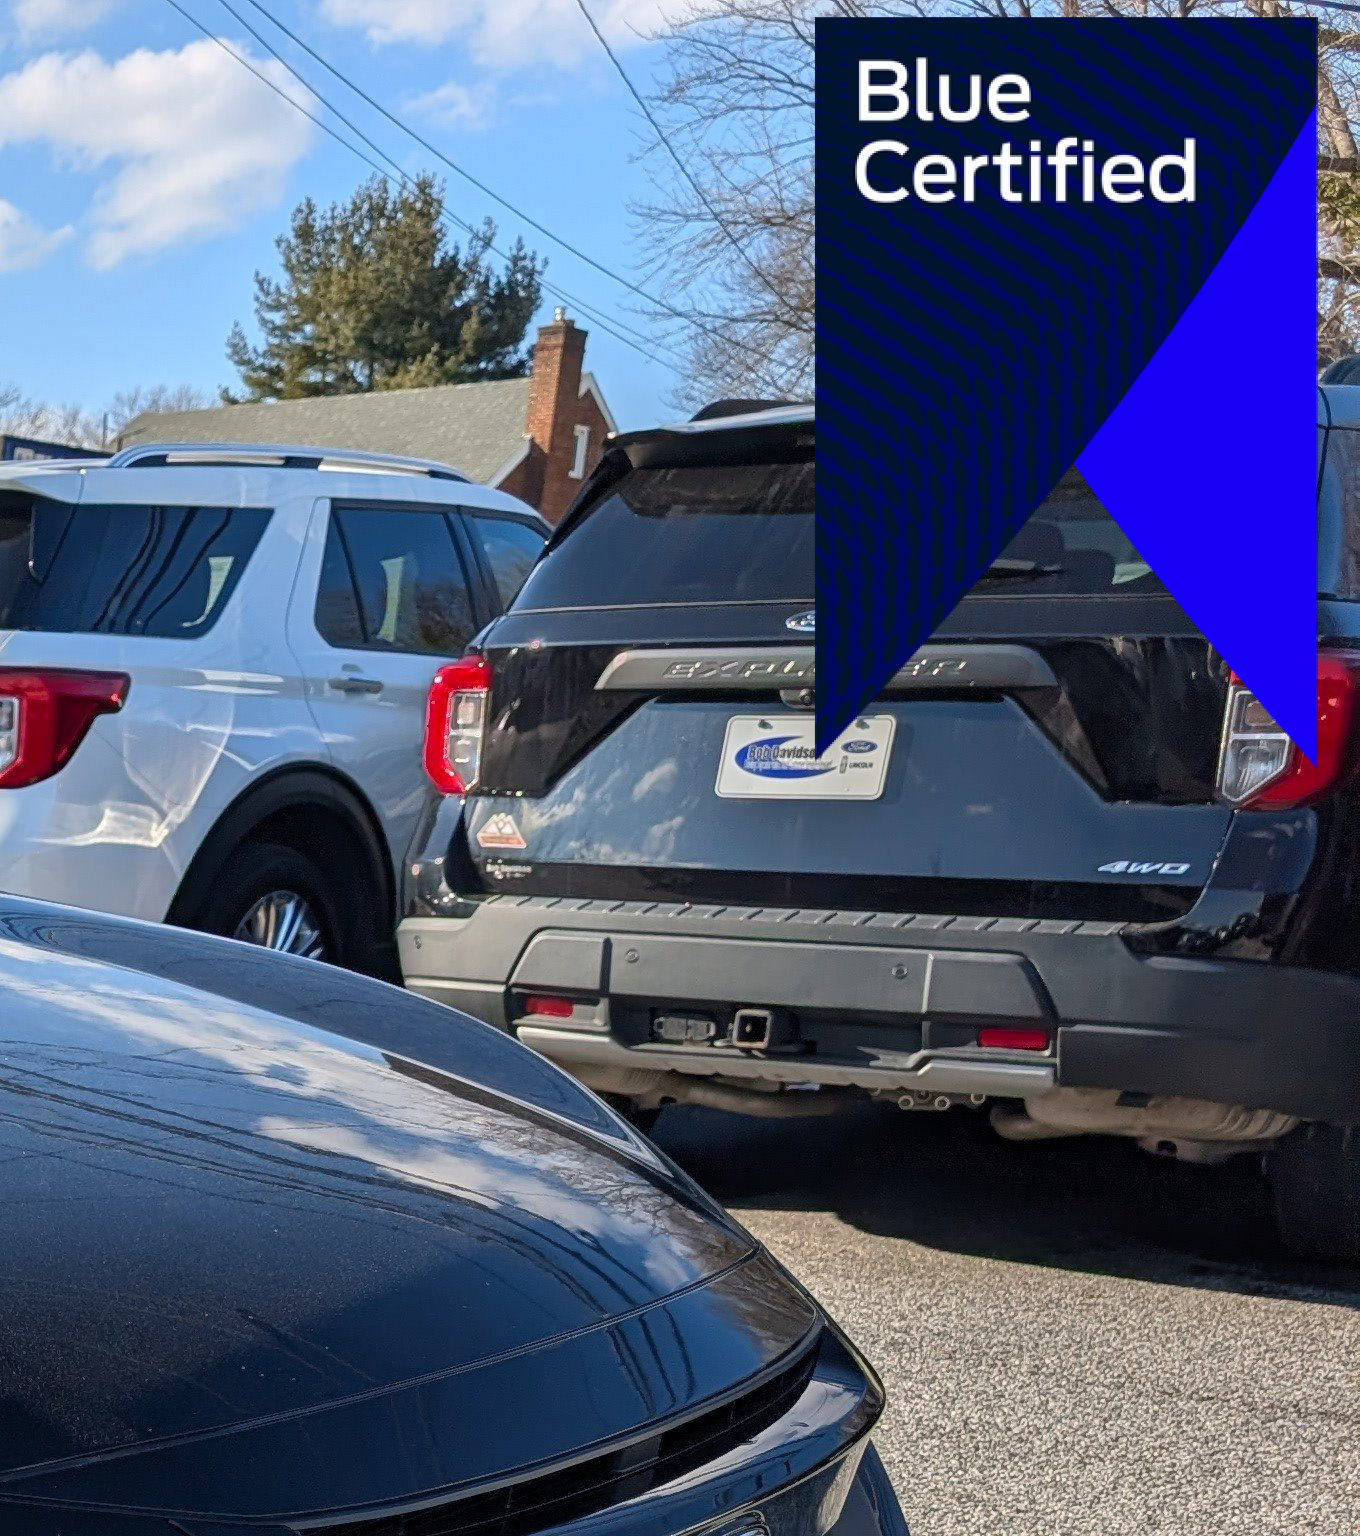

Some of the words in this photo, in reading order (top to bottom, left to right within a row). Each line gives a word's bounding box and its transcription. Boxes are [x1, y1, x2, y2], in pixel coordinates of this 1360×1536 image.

[663, 660, 967, 678] EXPLER
[747, 744, 771, 760] Bob
[772, 744, 823, 761] Davidso
[1098, 860, 1191, 875] 4WD
